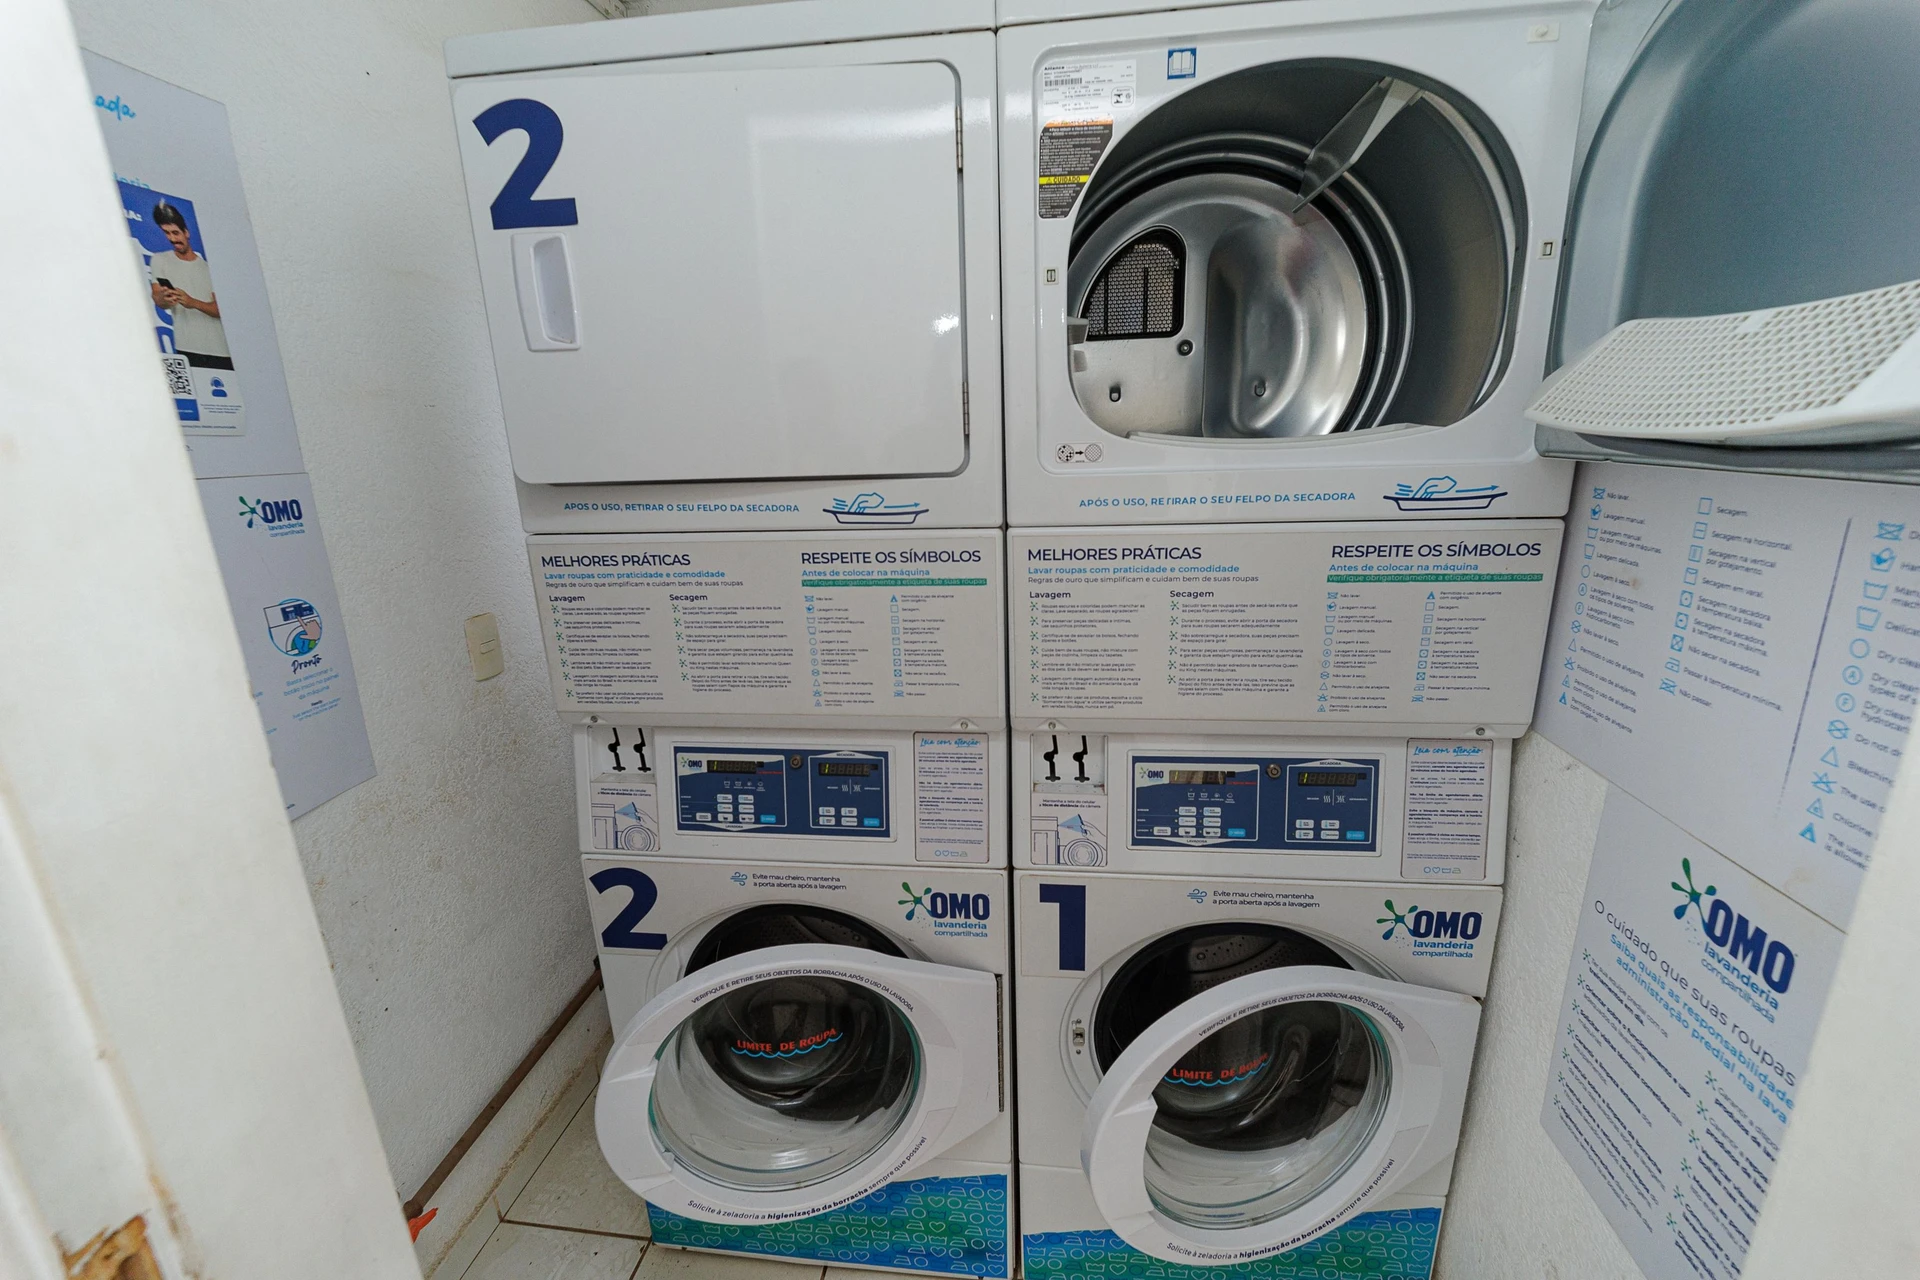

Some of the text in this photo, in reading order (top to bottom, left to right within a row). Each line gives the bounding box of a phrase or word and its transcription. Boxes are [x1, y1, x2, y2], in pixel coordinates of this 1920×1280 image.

[472, 98, 578, 230] 2
[1079, 498, 1108, 507] APÓS
[1123, 498, 1148, 506] USO,
[1211, 495, 1232, 504] SEU
[1235, 495, 1271, 503] FELPO
[1293, 492, 1355, 501] SECADORA
[261, 499, 303, 523] OMO
[625, 503, 664, 511] RETIRAR
[697, 504, 727, 512] FELPO
[746, 504, 799, 512] SECADORA
[268, 521, 304, 531] lavanderia
[801, 548, 981, 564] RESPEITE OS SÍMBOLOS
[1028, 544, 1201, 561] MELHORES PRÁTICAS
[1332, 541, 1541, 558] RESPEITE OS SÍMBOLOS
[541, 552, 690, 567] MELHORES PRÁTICAS
[1376, 563, 1414, 571] colocar
[1432, 562, 1478, 572] máquina
[673, 570, 725, 578] comodidade
[802, 568, 827, 576] Antes
[842, 568, 874, 576] colocar
[890, 568, 930, 577] máquina
[1113, 565, 1167, 574] praticidade
[1178, 564, 1239, 572] comodidade
[1445, 574, 1479, 582] etiqueta
[549, 595, 585, 603] Lavagem
[669, 594, 708, 602] Secagem
[1030, 591, 1071, 600] Lavagem
[1170, 590, 1214, 599] Secagem
[291, 653, 322, 674] Pronto
[920, 738, 934, 748] Leia
[955, 738, 980, 748] atenção:
[1413, 746, 1430, 756] Leia
[1453, 746, 1484, 757] atenção:
[688, 760, 702, 768] OMO
[1148, 770, 1164, 779] OMO
[589, 868, 668, 950] 2
[931, 892, 990, 920] OMO
[934, 920, 987, 929] lavanderia
[1040, 884, 1085, 971] 1
[1412, 910, 1482, 940] OMO
[1414, 940, 1473, 949] lavanderia
[1708, 899, 1794, 994] OMO
[1412, 950, 1473, 958] compartilhada
[1610, 934, 1636, 963] Saiba
[1637, 960, 1666, 991] quais
[1668, 988, 1681, 1004] as
[1704, 941, 1779, 1010] lavanderia
[1594, 900, 1796, 1087] O cuidado que suas roupas
[1701, 958, 1776, 1024] compartilhada
[1616, 956, 1755, 1093] administração predial na
[738, 1029, 836, 1051] LIMITE DE ROUPA
[1173, 1069, 1211, 1079] LIMITE
[1221, 1069, 1235, 1078] DE
[688, 1200, 715, 1213] Solicite
[722, 1211, 759, 1220] zeladoria
[767, 1206, 821, 1220] higienização
[833, 1188, 868, 1207] borracha
[868, 1170, 894, 1191] sempre
[894, 1160, 906, 1172] que
[906, 1137, 926, 1161] possível
